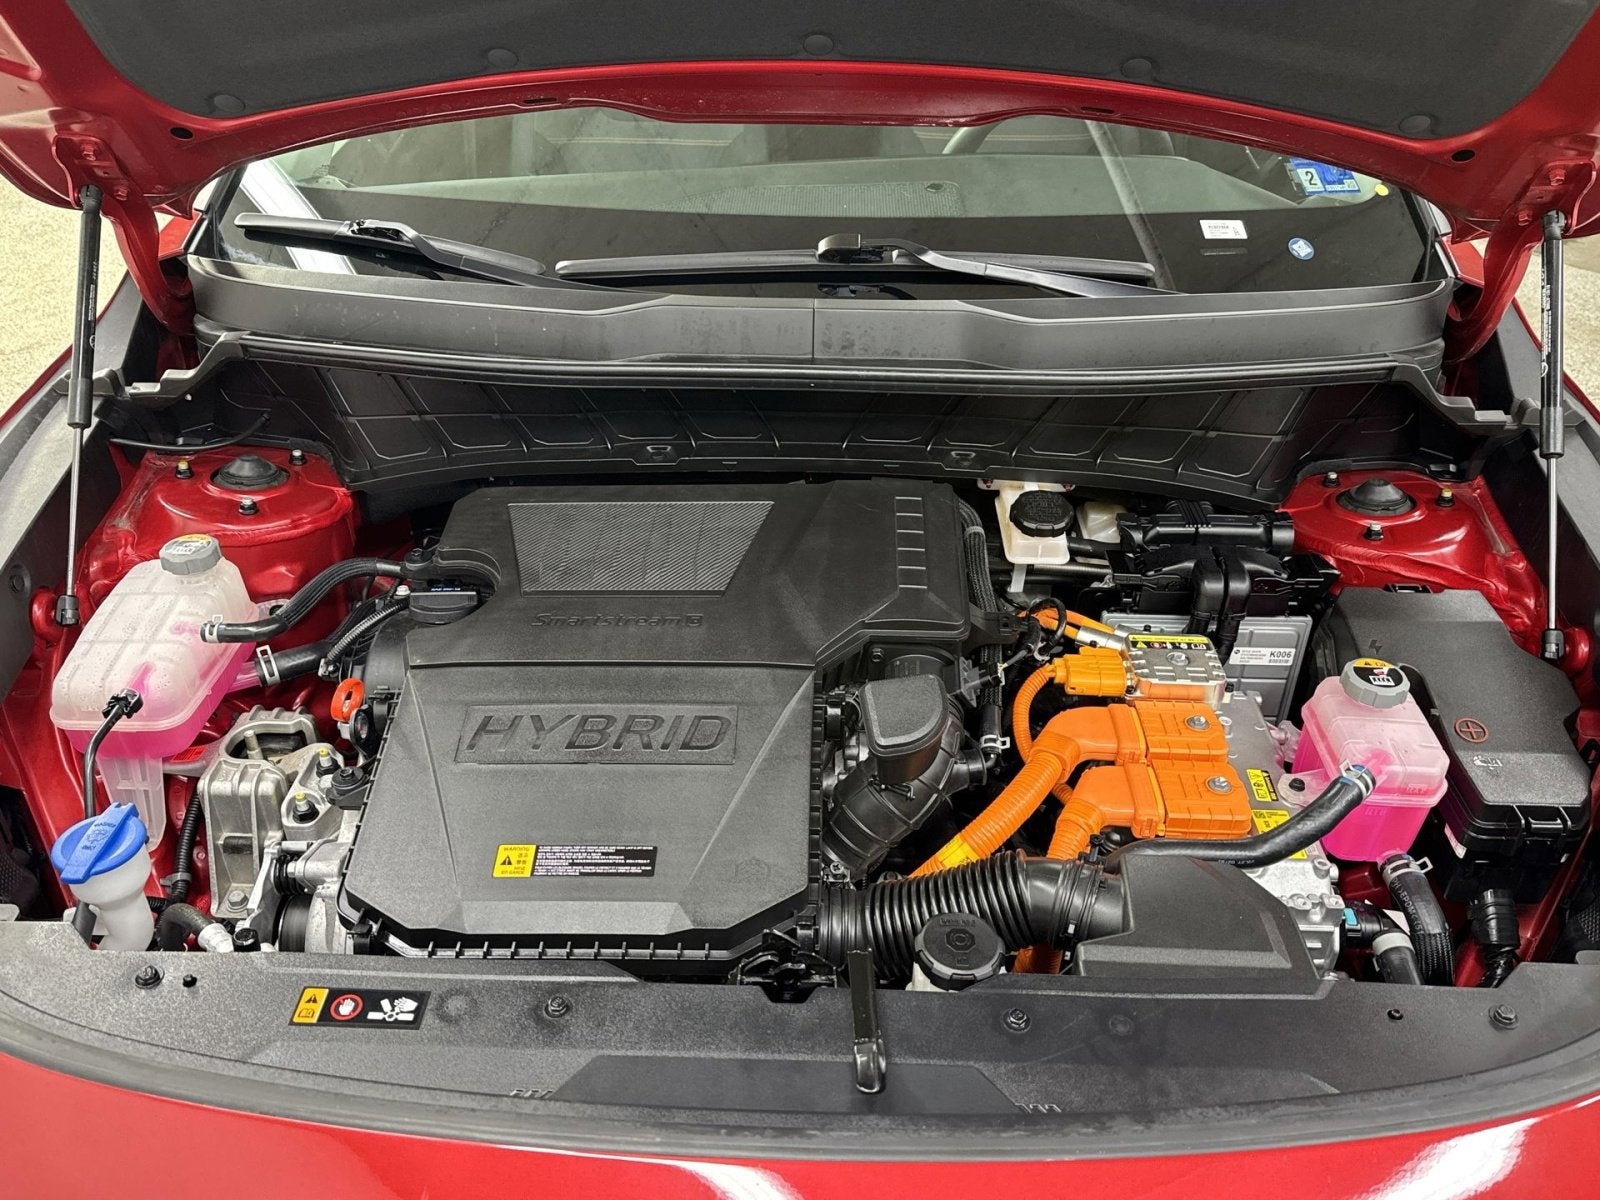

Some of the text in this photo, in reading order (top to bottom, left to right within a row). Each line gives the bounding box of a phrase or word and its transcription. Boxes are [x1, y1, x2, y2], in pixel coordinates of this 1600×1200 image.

[1305, 170, 1318, 186] 2
[531, 613, 682, 627] Smartstream
[1269, 650, 1292, 659] K006
[465, 714, 732, 752] HYBRID
